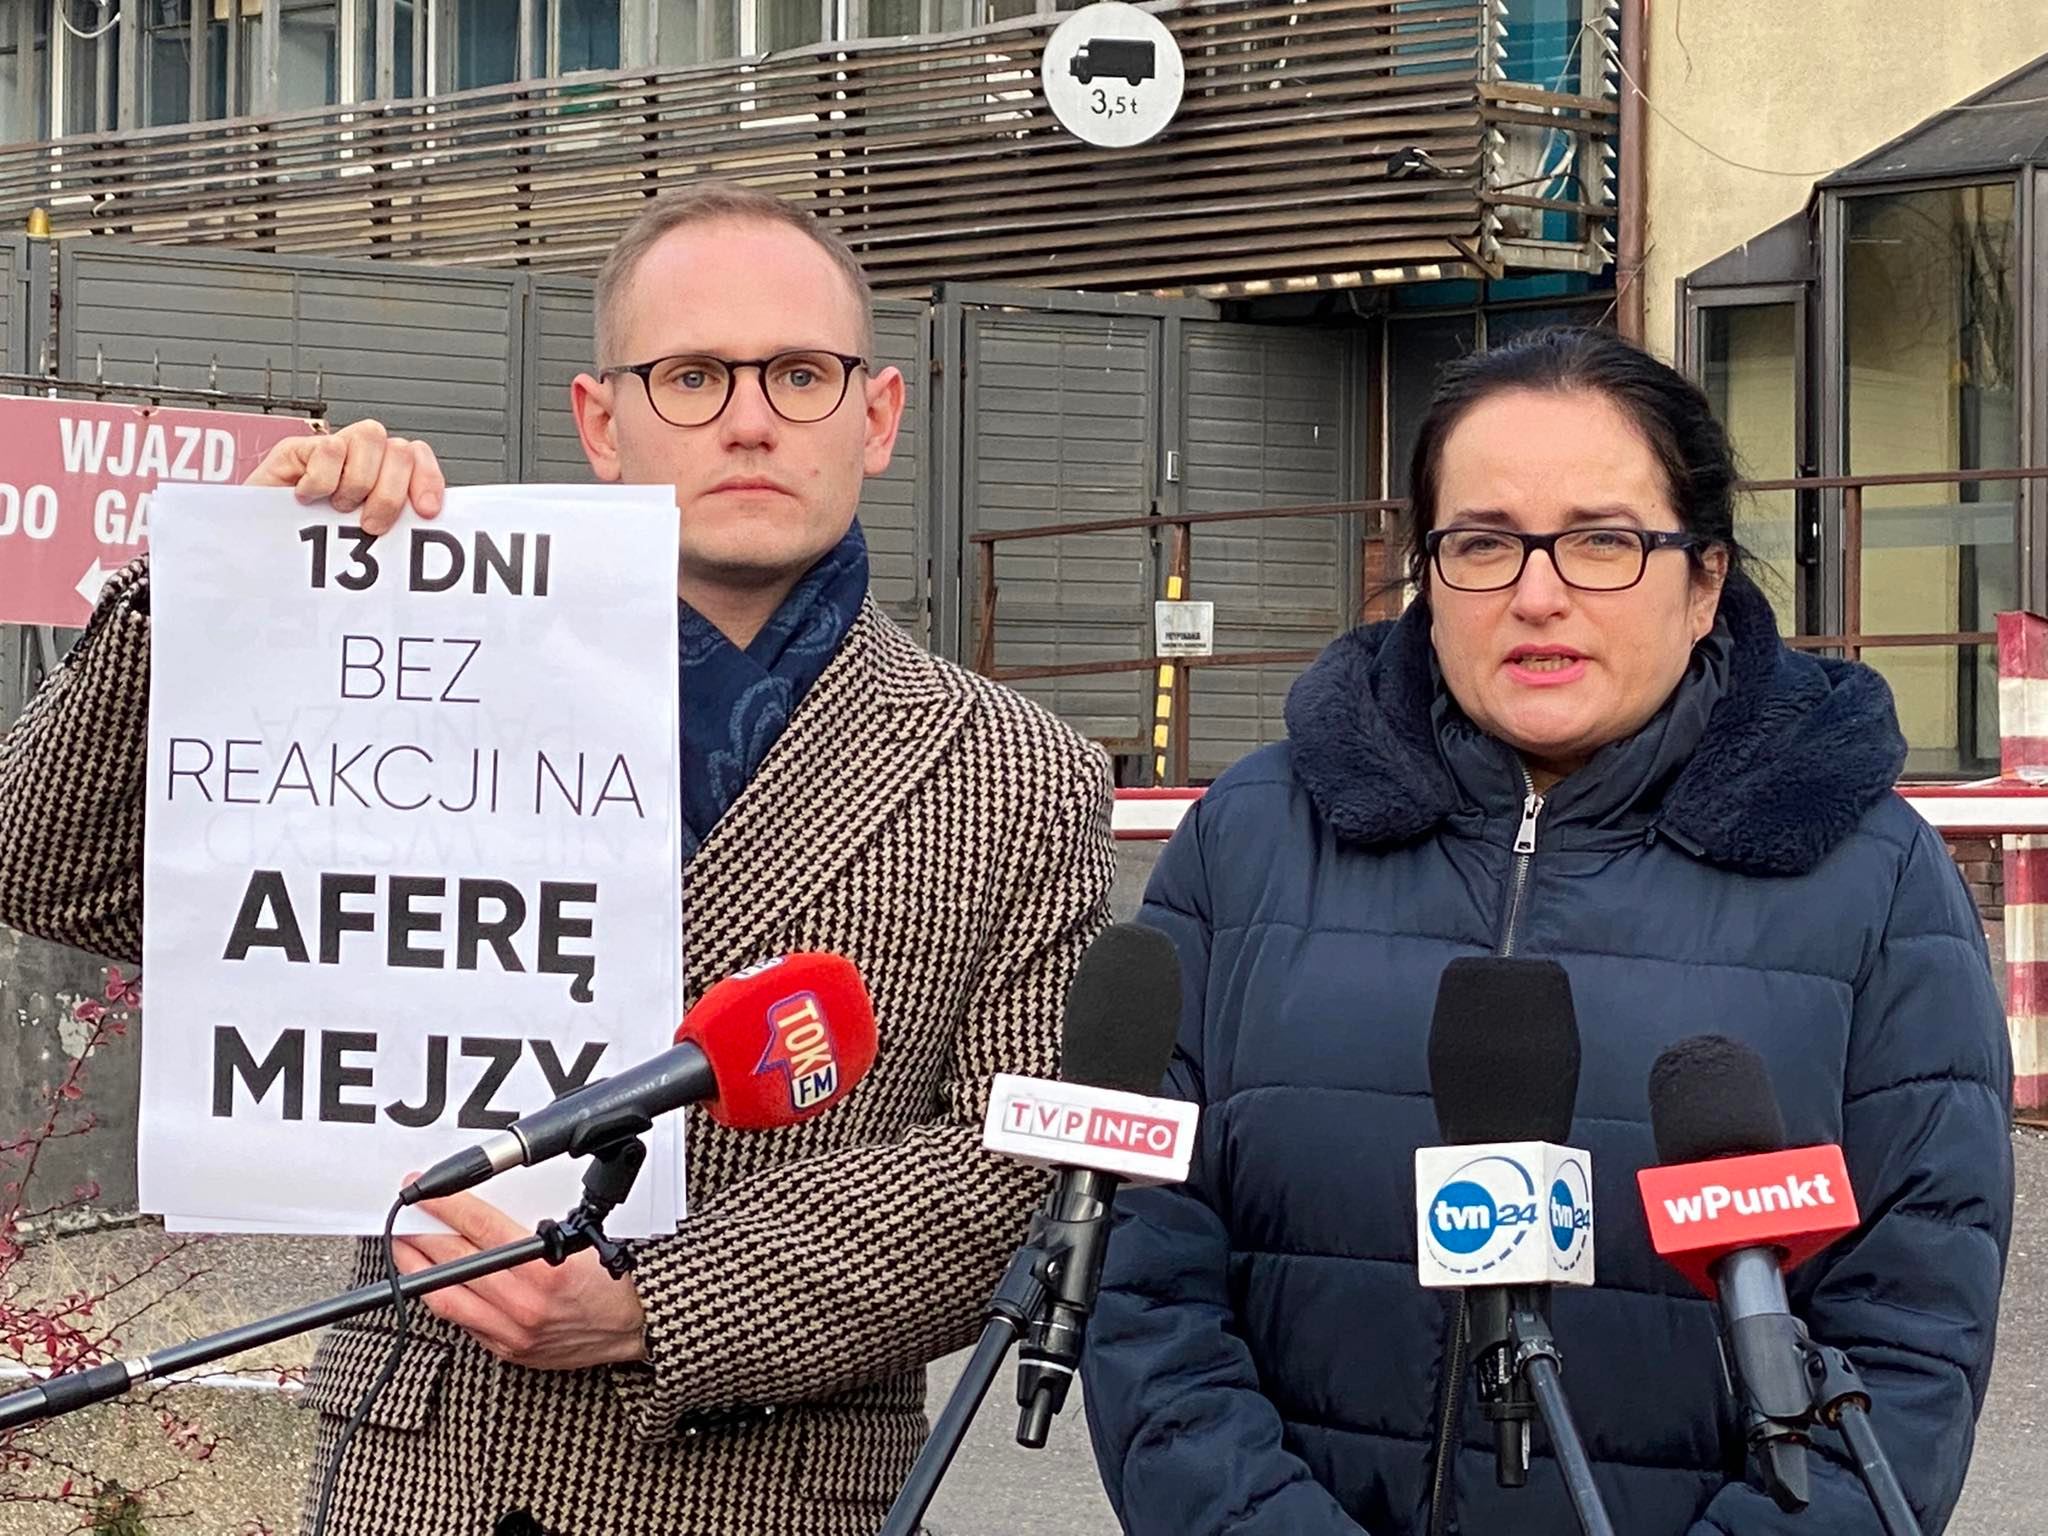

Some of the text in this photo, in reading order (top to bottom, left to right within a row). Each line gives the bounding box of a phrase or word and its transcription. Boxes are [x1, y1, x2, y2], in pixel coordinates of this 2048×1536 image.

[1091, 89, 1138, 119] 3,5 t
[59, 418, 235, 482] WJAZD
[299, 524, 552, 597] 13 DNI
[340, 634, 482, 703] BEZ
[167, 737, 645, 819] REAKCJI NA
[221, 869, 598, 1003] AFERĘ
[777, 999, 832, 1077] TOK
[212, 1024, 609, 1130] MEJZY
[799, 1066, 833, 1104] FM
[1012, 1102, 1172, 1151] TVP INFO
[1663, 1173, 1836, 1225] wPunkt
